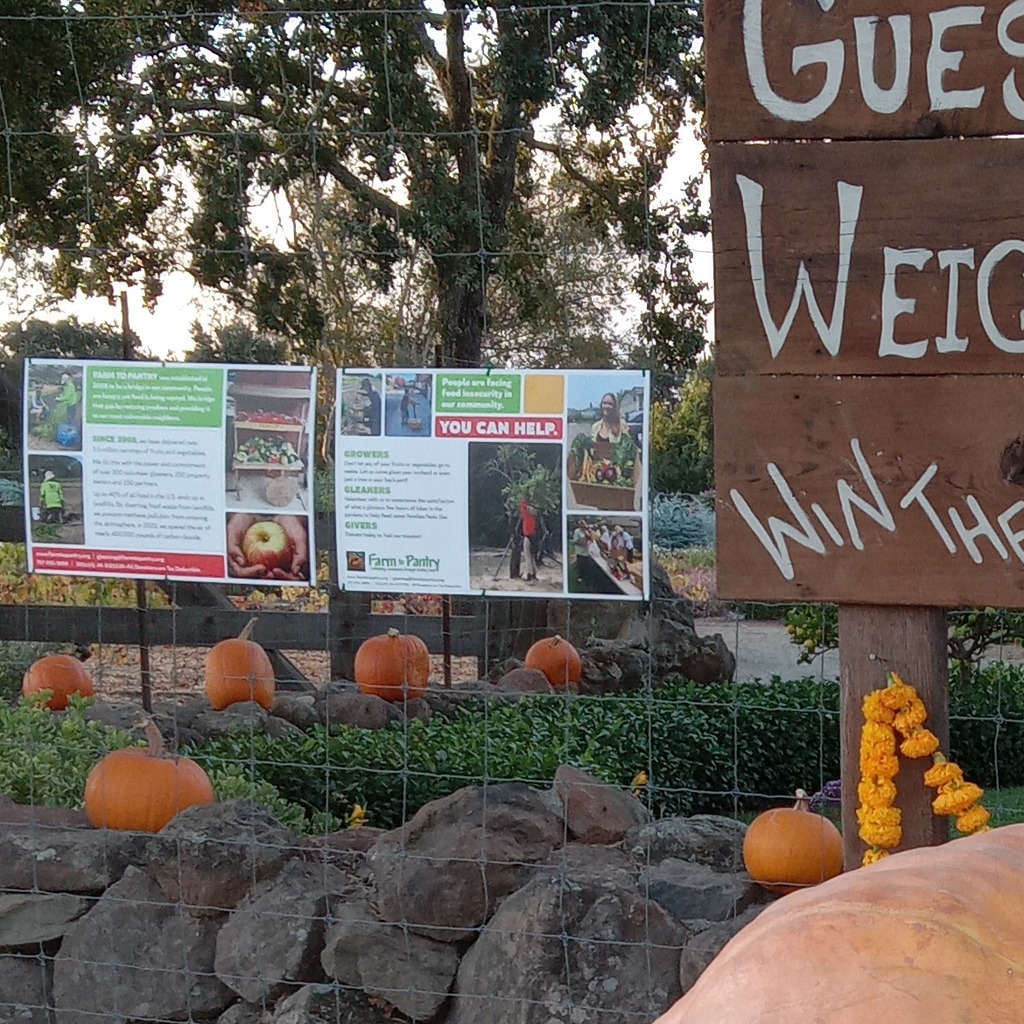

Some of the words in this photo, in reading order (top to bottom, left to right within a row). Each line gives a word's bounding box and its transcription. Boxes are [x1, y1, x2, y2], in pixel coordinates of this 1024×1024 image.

[442, 378, 470, 388] People
[486, 379, 512, 388] facing
[442, 389, 461, 398] food
[462, 389, 503, 399] insecurity
[504, 390, 513, 398] in
[457, 401, 504, 411] community.
[439, 421, 472, 434] YOU
[476, 421, 510, 435] CAN
[514, 421, 558, 436] HELP.
[344, 450, 390, 458] GROWERS
[344, 486, 391, 495] GLEANERS
[345, 521, 378, 530] GIVERS
[368, 553, 397, 567] Farm
[406, 555, 440, 572] Pantry
